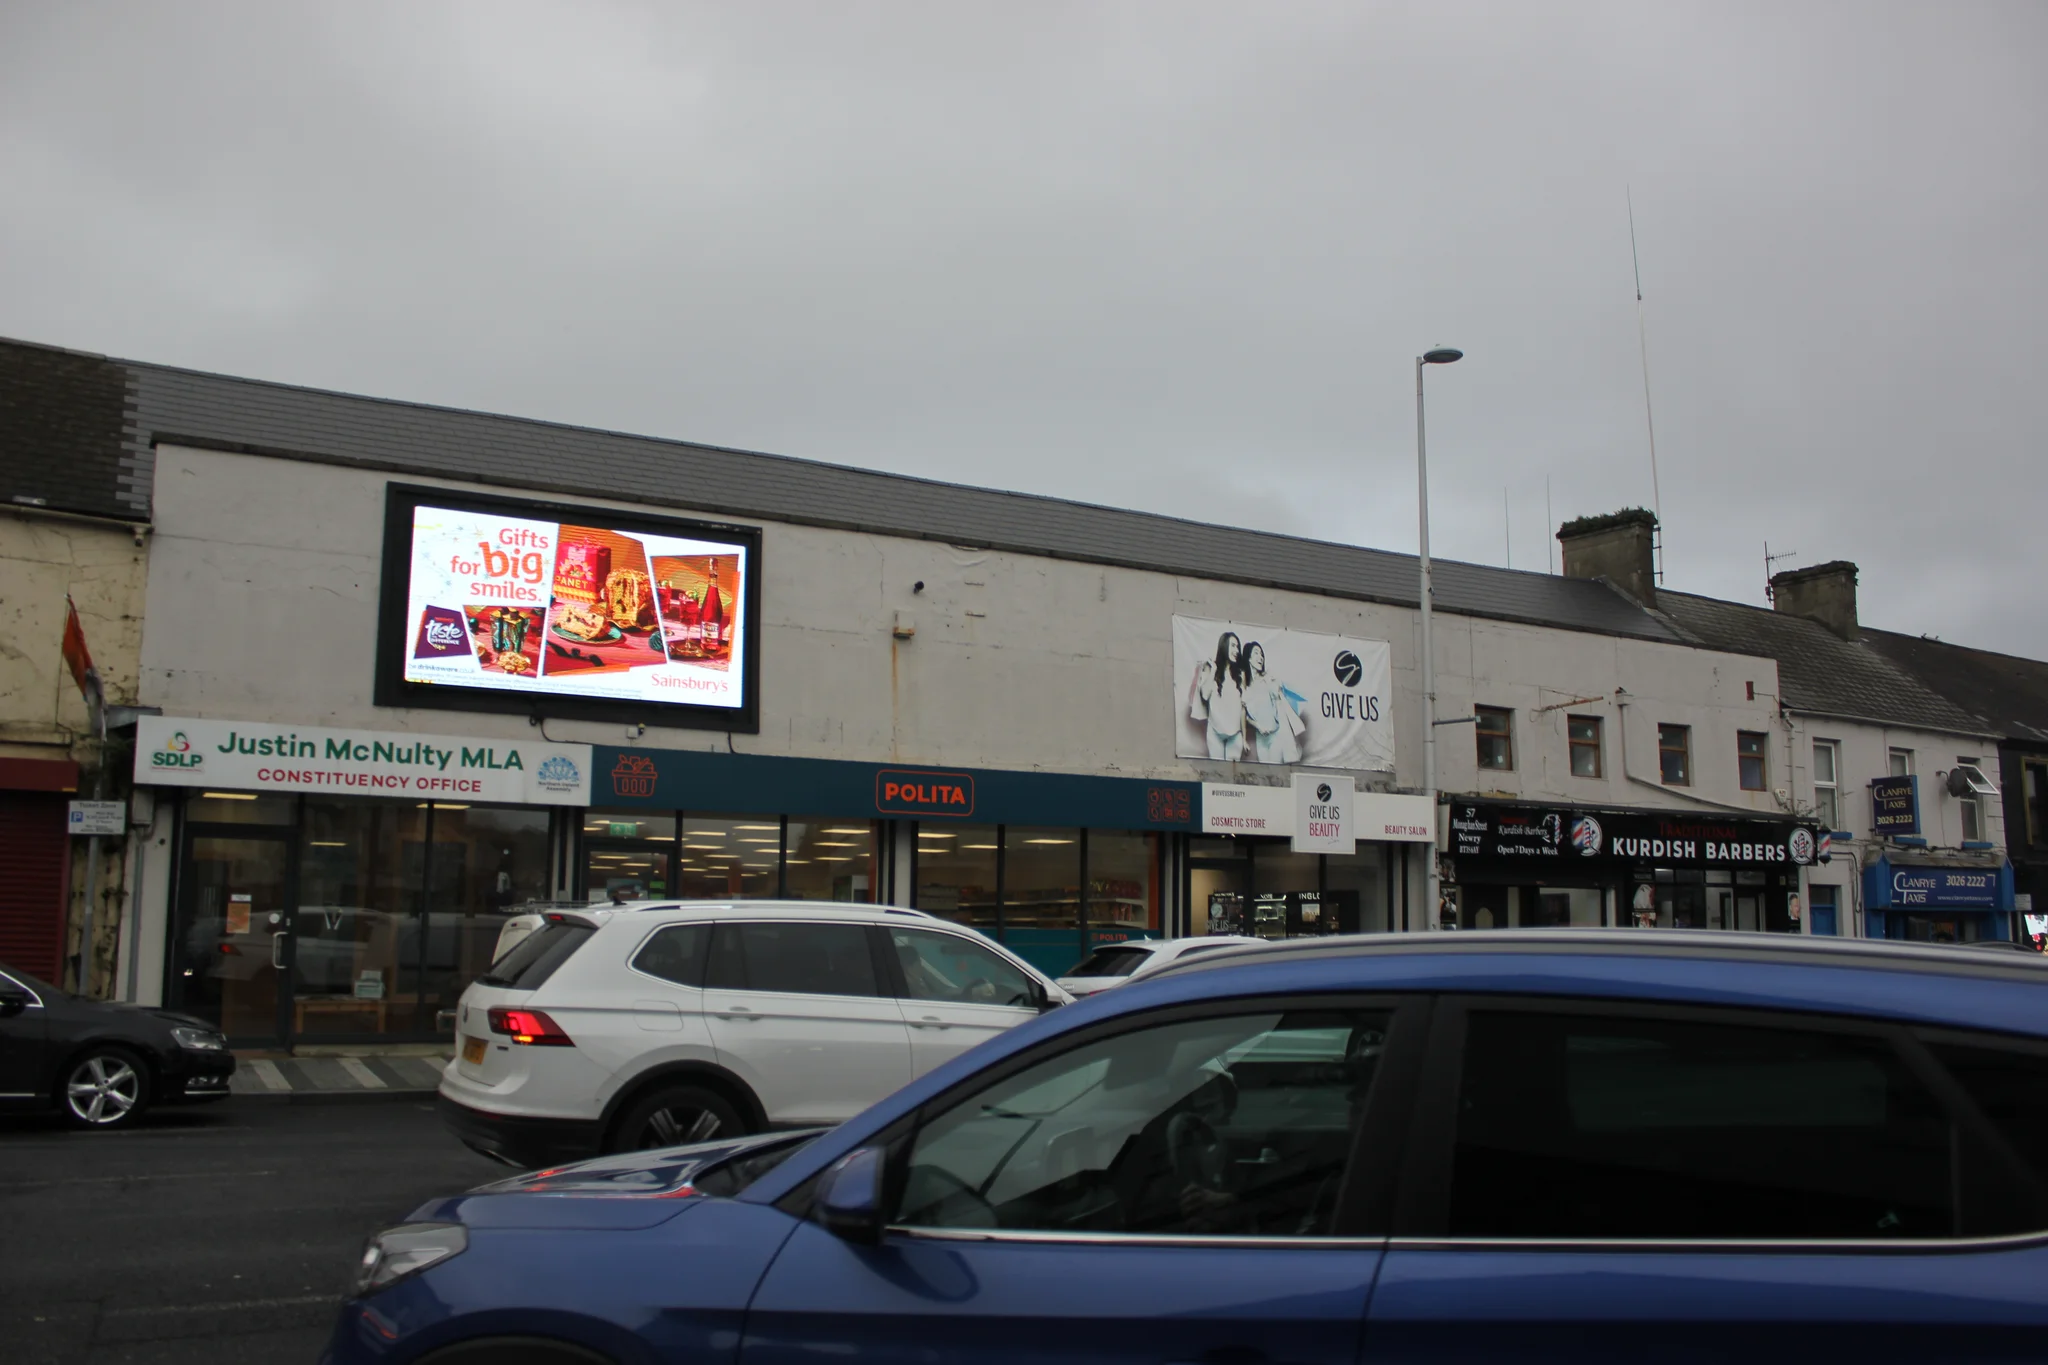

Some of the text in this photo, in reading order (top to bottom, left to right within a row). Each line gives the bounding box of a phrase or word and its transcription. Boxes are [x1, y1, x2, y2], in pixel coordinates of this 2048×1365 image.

[499, 527, 549, 550] Gifts
[450, 541, 543, 585] for big
[470, 580, 543, 603] smiles.
[425, 619, 464, 645] taste
[651, 673, 728, 693] Sainsbury's
[1321, 691, 1379, 722] GIVE US
[152, 751, 203, 767] SDLP
[217, 731, 524, 771] Justin McNulty MLA
[257, 768, 482, 793] CONSTITUENCY OFFICE
[884, 782, 967, 805] POLITA
[1874, 785, 1913, 801] CLANRYE
[1883, 798, 1906, 810] TAXIS
[1309, 804, 1340, 821] GIVE US
[1466, 808, 1476, 818] 57
[1877, 815, 1913, 825] 3026 2222
[1211, 816, 1266, 829] COSMETIC STORE
[1309, 822, 1340, 837] BEAUTY
[1384, 825, 1427, 836] BEAUTY SALON
[1498, 824, 1548, 836] Kurdish Barbers
[1458, 833, 1481, 844] Newry
[1498, 845, 1514, 855] Open
[1519, 845, 1535, 856] Days
[1542, 846, 1558, 856] Week
[1612, 837, 1785, 862] KURDISH BARBERS
[1893, 871, 1936, 892] CLANRYE
[1946, 875, 1986, 887] 3026 2222
[1902, 890, 1927, 904] TAXIS
[1100, 933, 1128, 941] POLITA
